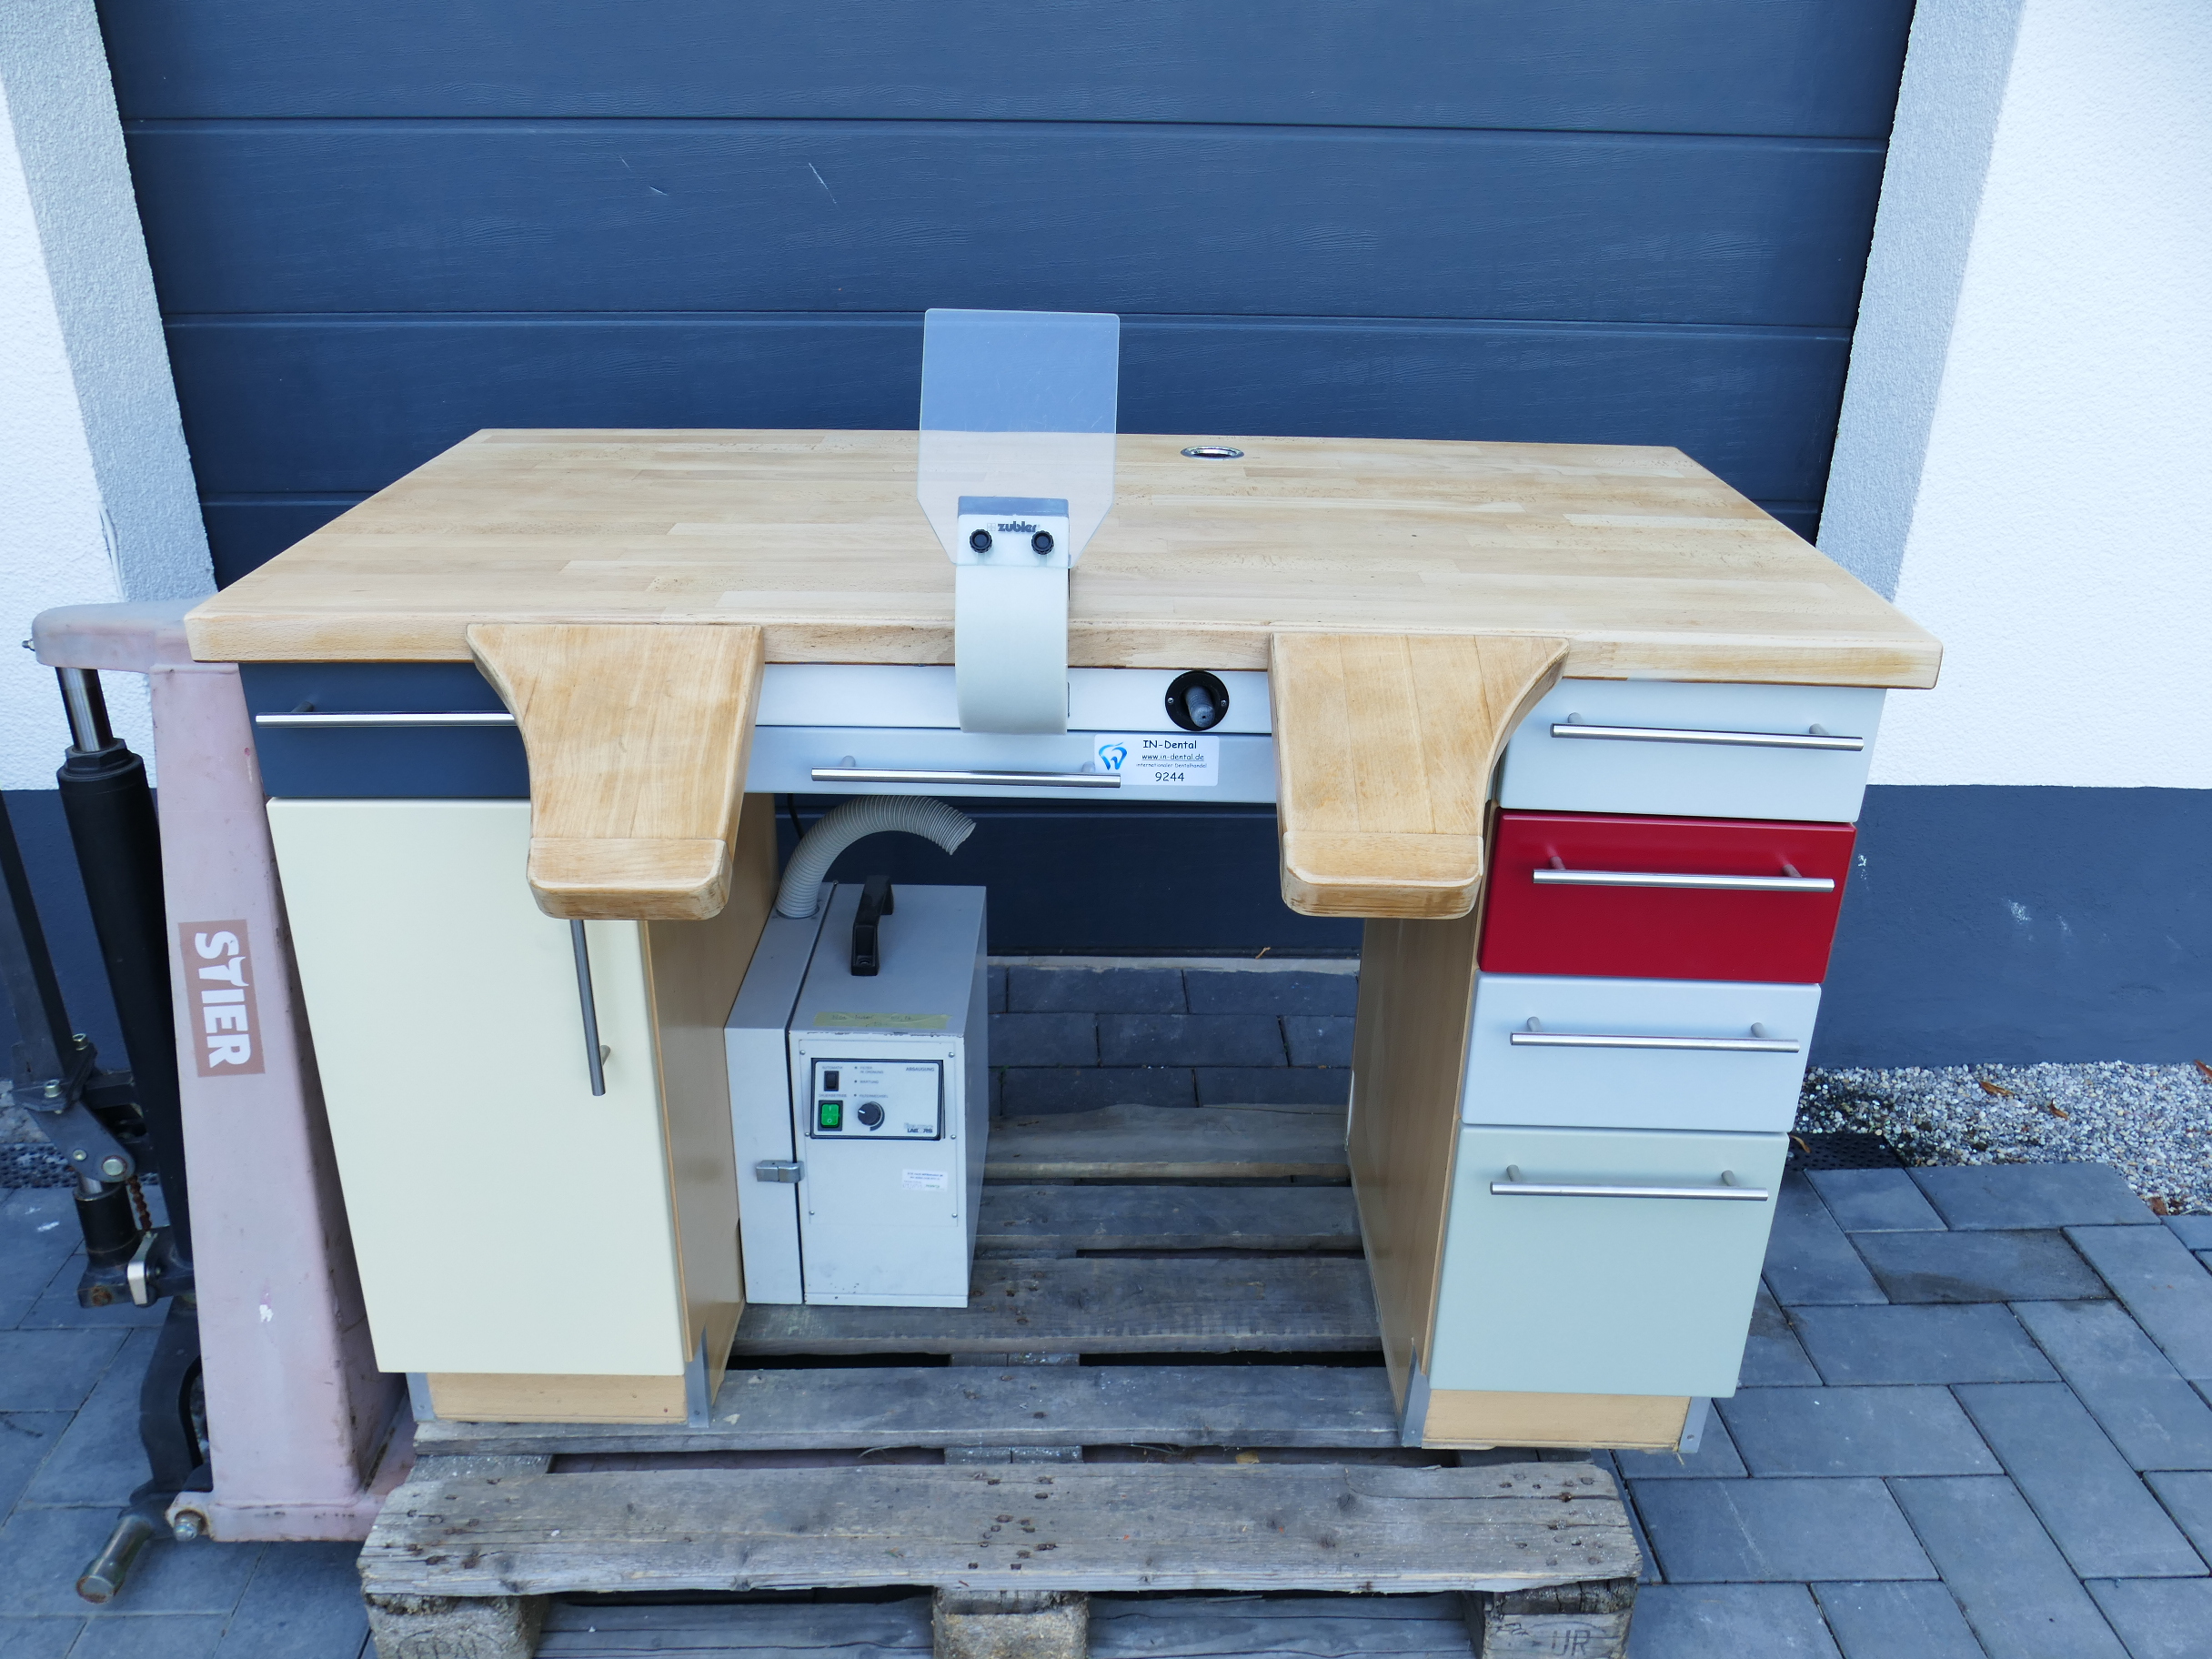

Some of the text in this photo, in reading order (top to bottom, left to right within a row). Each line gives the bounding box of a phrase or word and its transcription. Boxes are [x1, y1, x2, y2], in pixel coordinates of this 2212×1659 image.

[997, 521, 1037, 533] zubler
[1142, 739, 1197, 749] IN-Dental
[1141, 753, 1204, 761] www.in-dental.de
[1154, 771, 1185, 782] 9244
[194, 930, 251, 1069] STIER
